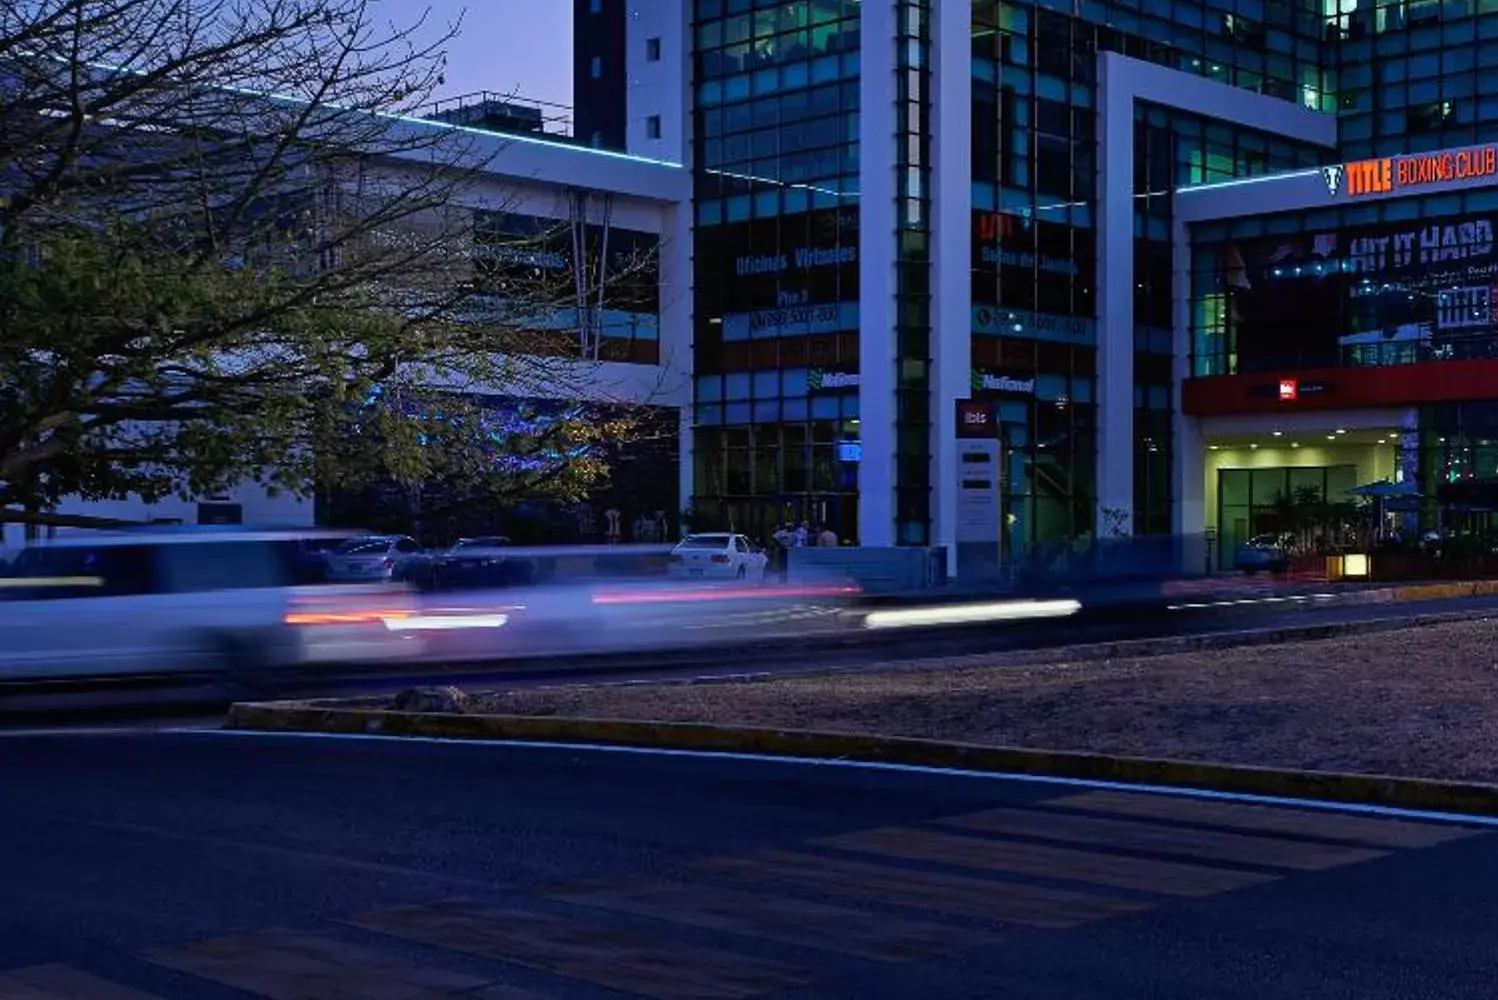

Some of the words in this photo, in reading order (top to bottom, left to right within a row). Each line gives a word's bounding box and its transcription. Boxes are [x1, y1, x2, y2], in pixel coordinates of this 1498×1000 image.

[1345, 158, 1392, 195] TITLE
[1397, 154, 1454, 184] BOXING
[1455, 147, 1497, 179] CLUB
[1350, 235, 1390, 274] HIT
[1393, 230, 1416, 268] IT
[1419, 218, 1494, 264] HARD
